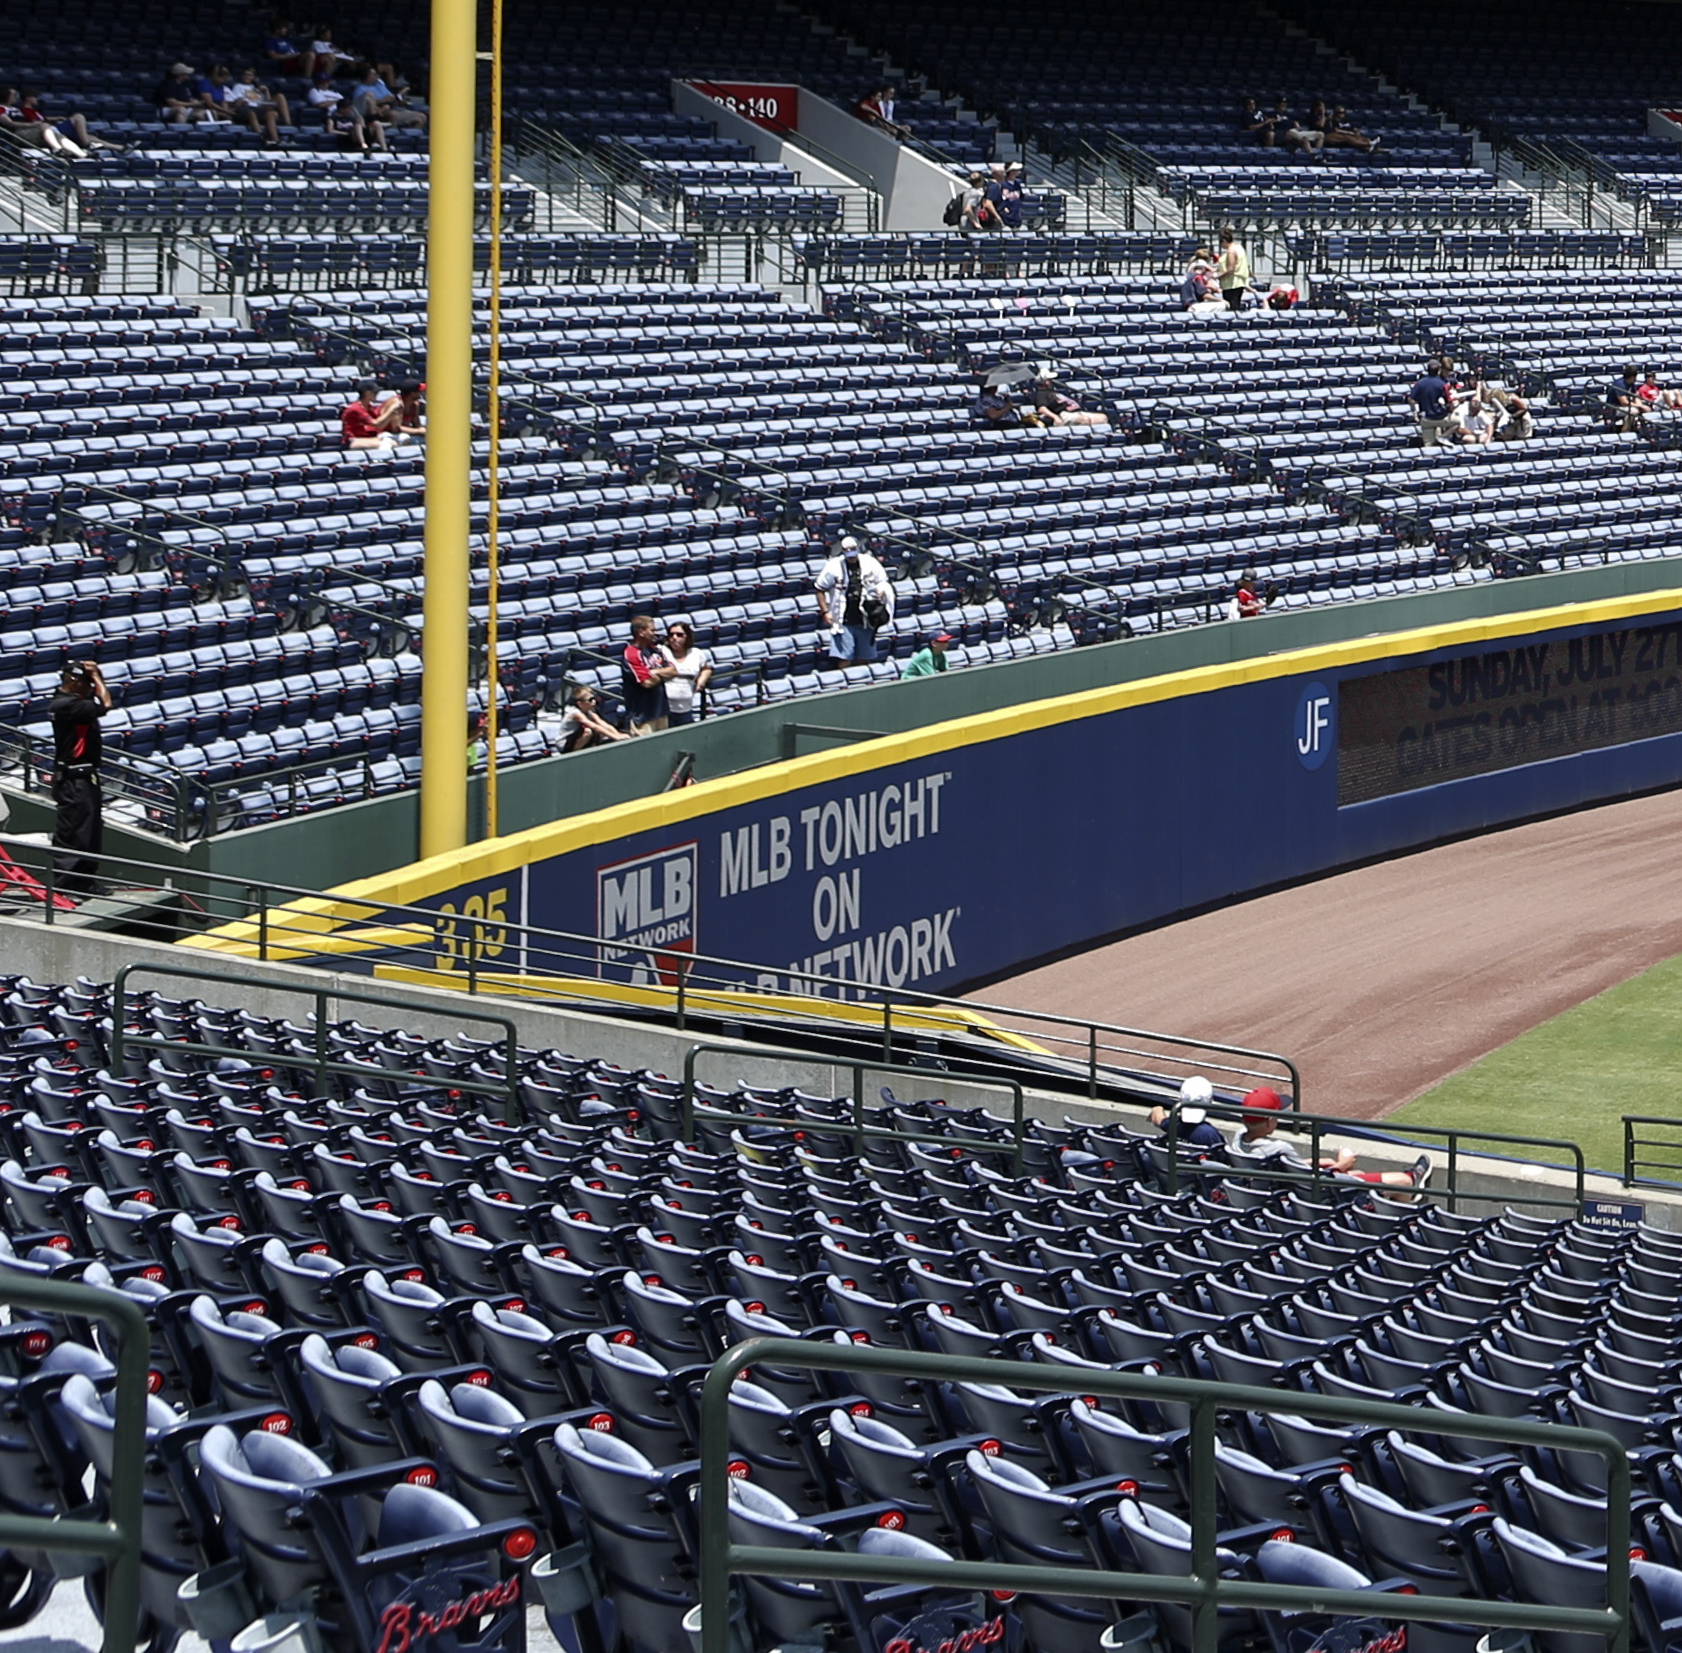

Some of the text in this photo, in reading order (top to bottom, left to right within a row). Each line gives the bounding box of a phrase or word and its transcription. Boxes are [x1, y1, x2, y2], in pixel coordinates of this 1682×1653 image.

[748, 97, 777, 119] 140
[1427, 642, 1553, 711] SUNDAY,
[1556, 630, 1629, 686] JULY
[1298, 696, 1329, 755] JF
[720, 775, 945, 897] MLB TONIGHT
[603, 856, 692, 939] MLB
[813, 868, 860, 942] ON
[604, 917, 691, 961] NETWORK
[1597, 1204, 1622, 1214] CAUTION
[28, 1337, 48, 1349] 104
[268, 1419, 288, 1432] 102
[413, 1474, 432, 1487] 101
[884, 1514, 900, 1529] 101
